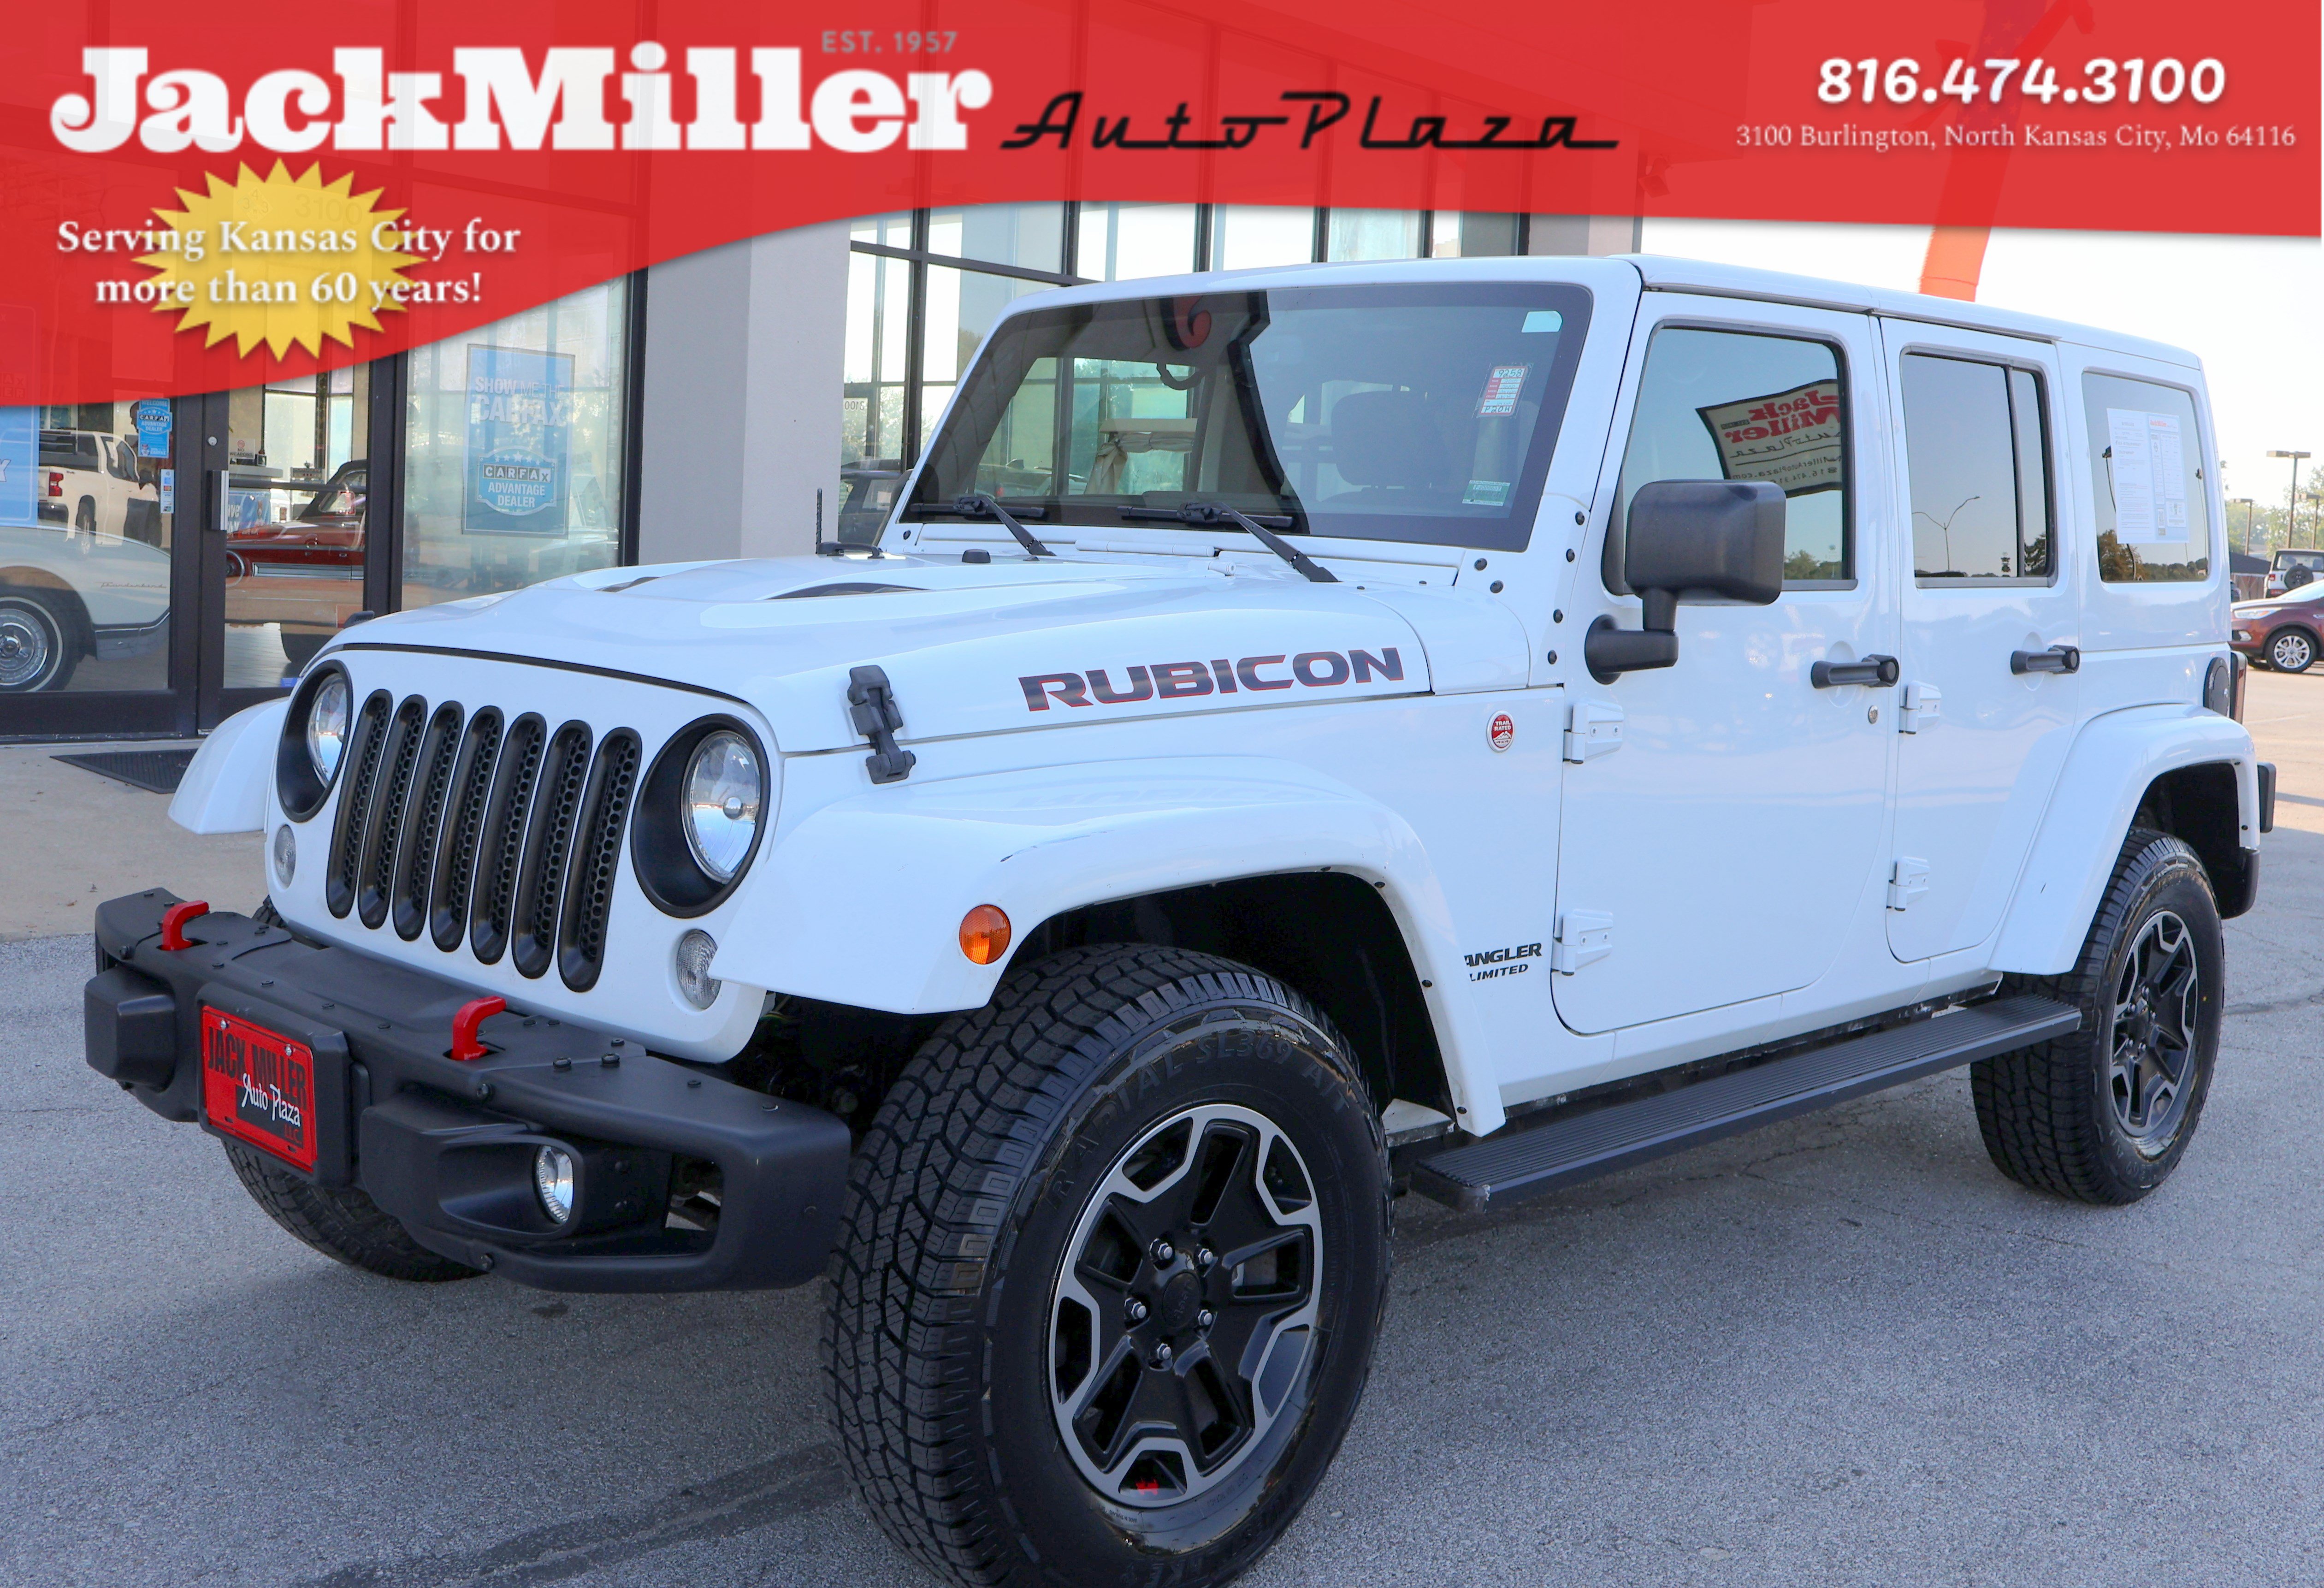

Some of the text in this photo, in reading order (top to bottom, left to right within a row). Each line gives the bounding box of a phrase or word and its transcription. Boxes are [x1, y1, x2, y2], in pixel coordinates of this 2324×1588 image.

[474, 376, 517, 394] SHOW
[1498, 369, 1523, 378] 9258
[474, 395, 565, 427] CARFAX
[485, 465, 550, 483] CARFAX
[488, 481, 546, 497] ADVANTAGE
[497, 494, 535, 508] DEALER
[1018, 647, 1404, 711] RUBICON
[1195, 1029, 1295, 1065] SL369
[207, 1026, 308, 1112] JACK MILLER
[241, 1072, 302, 1128] Auto Plaza
